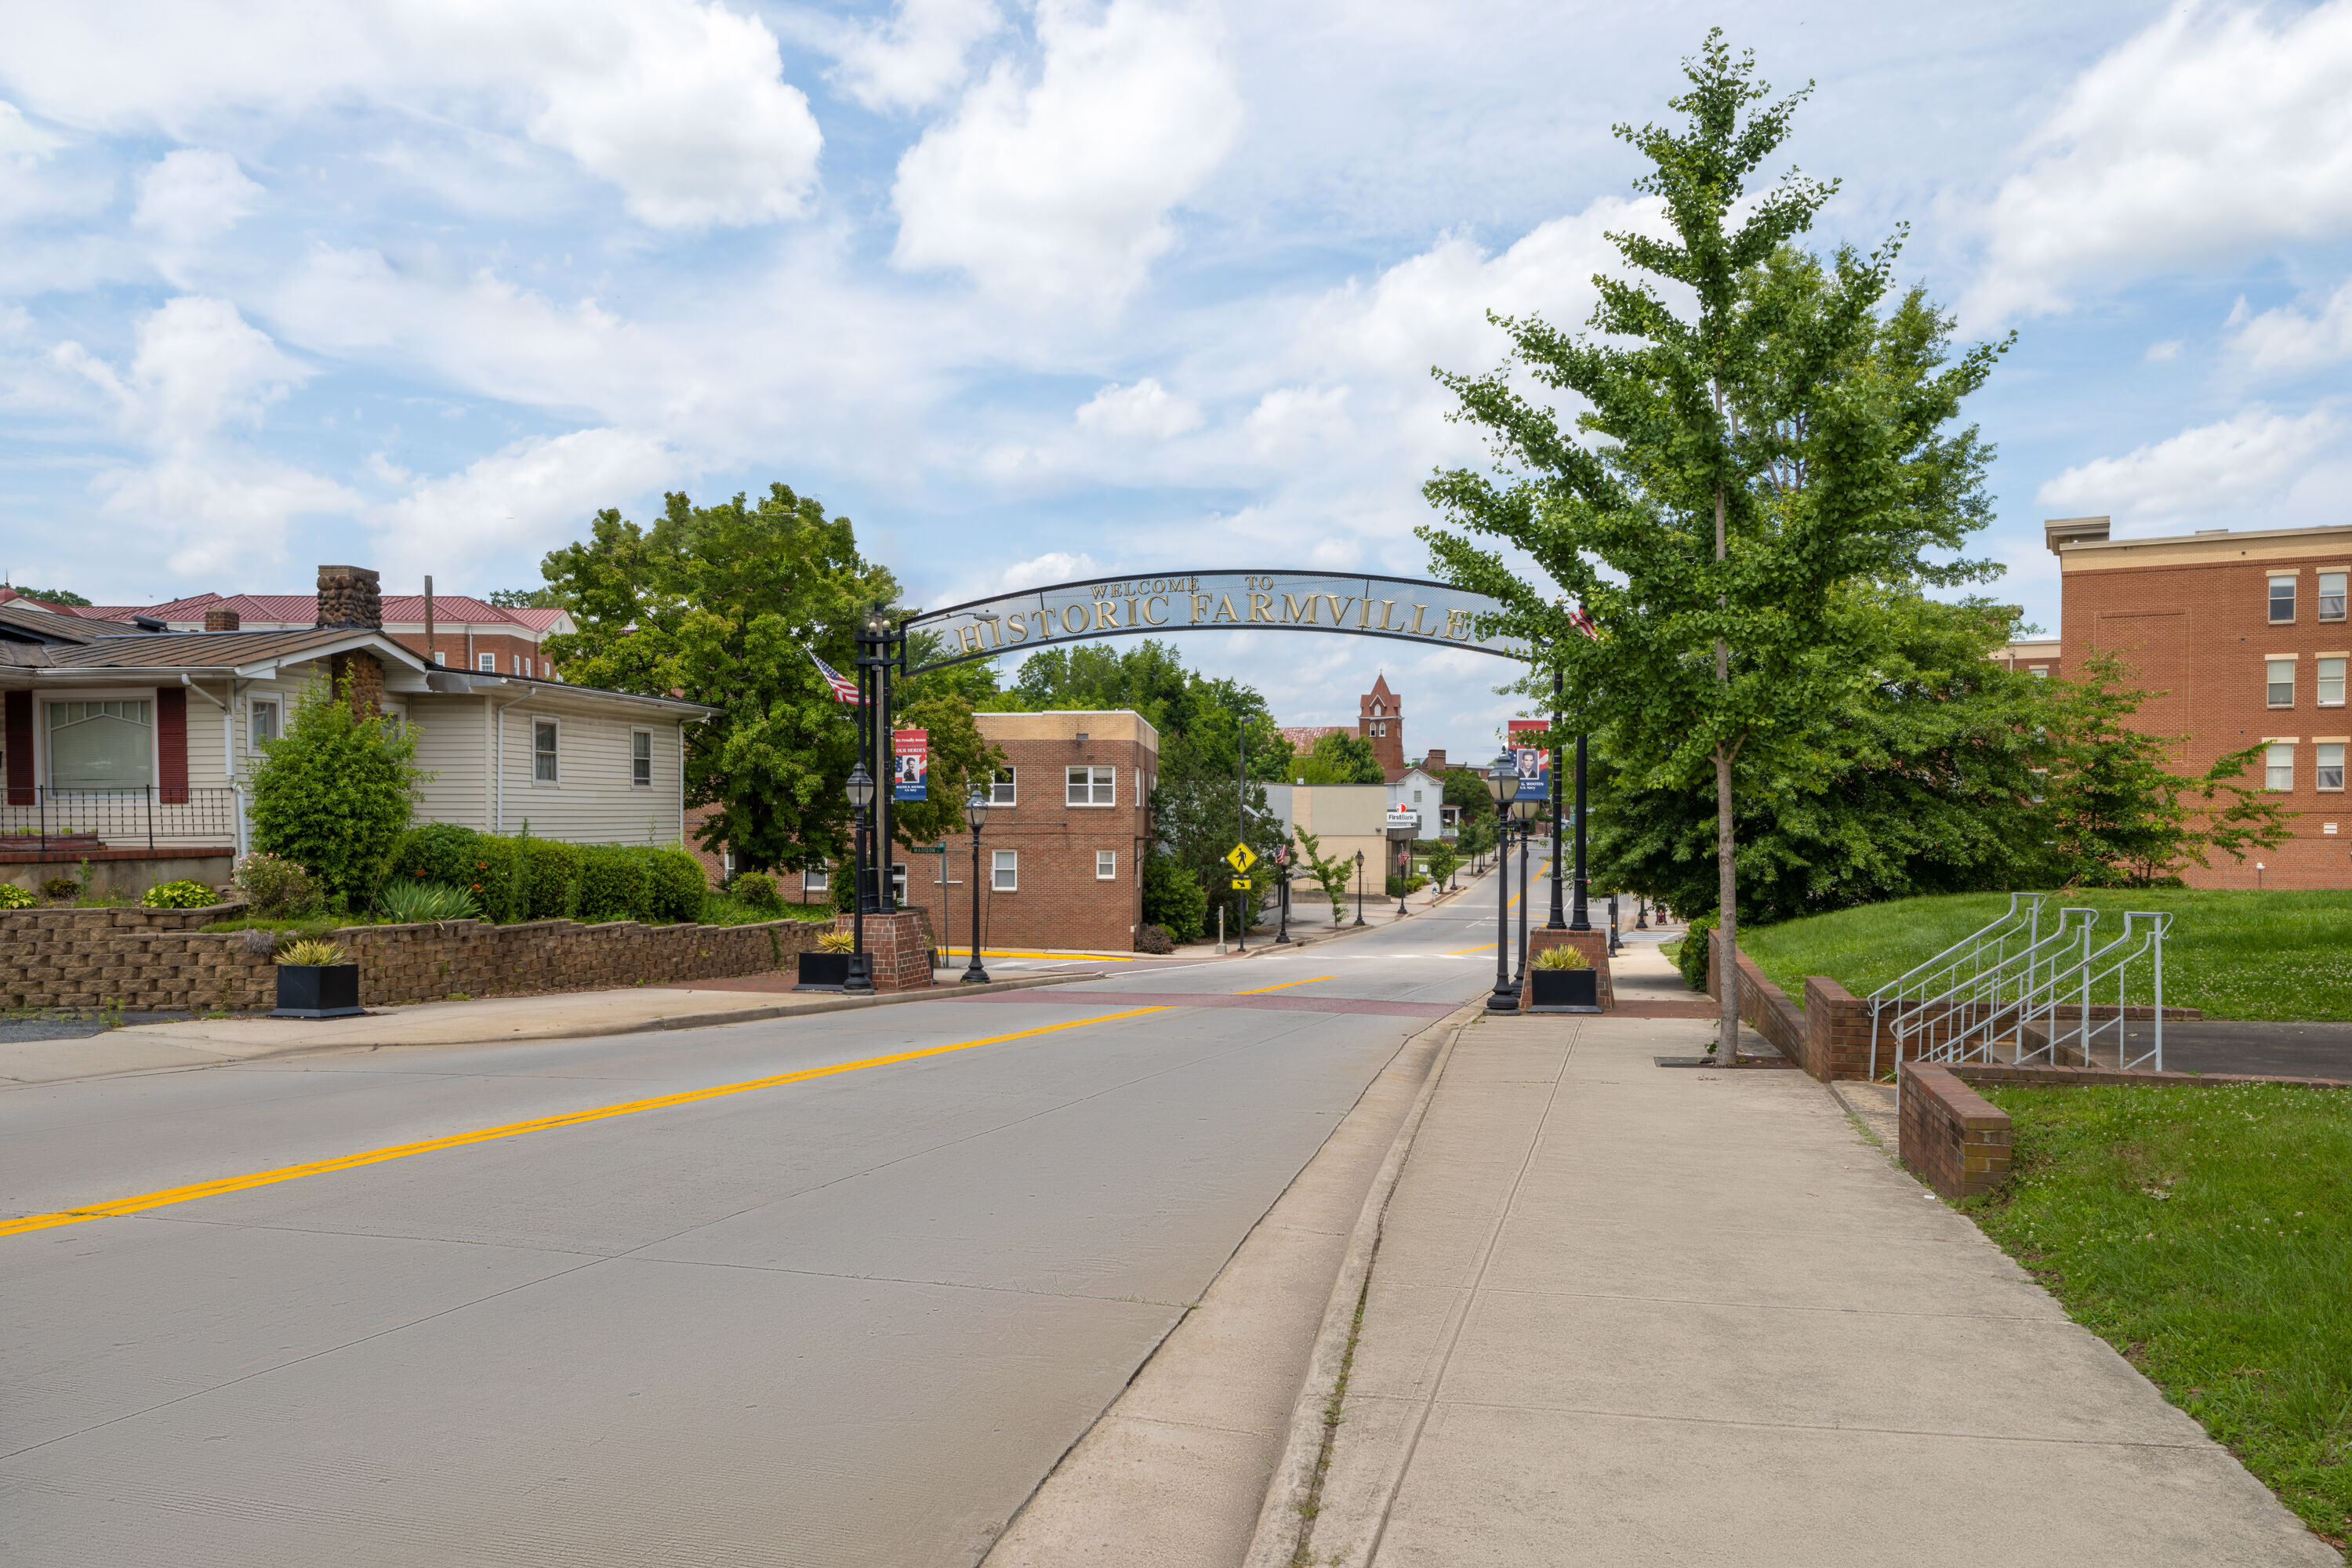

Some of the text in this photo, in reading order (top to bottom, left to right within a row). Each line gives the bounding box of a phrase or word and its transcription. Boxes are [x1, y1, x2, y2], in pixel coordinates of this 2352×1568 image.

[1091, 576, 1274, 600] WELCOME TO
[954, 593, 1473, 655] HISTORIC FARMVILLE
